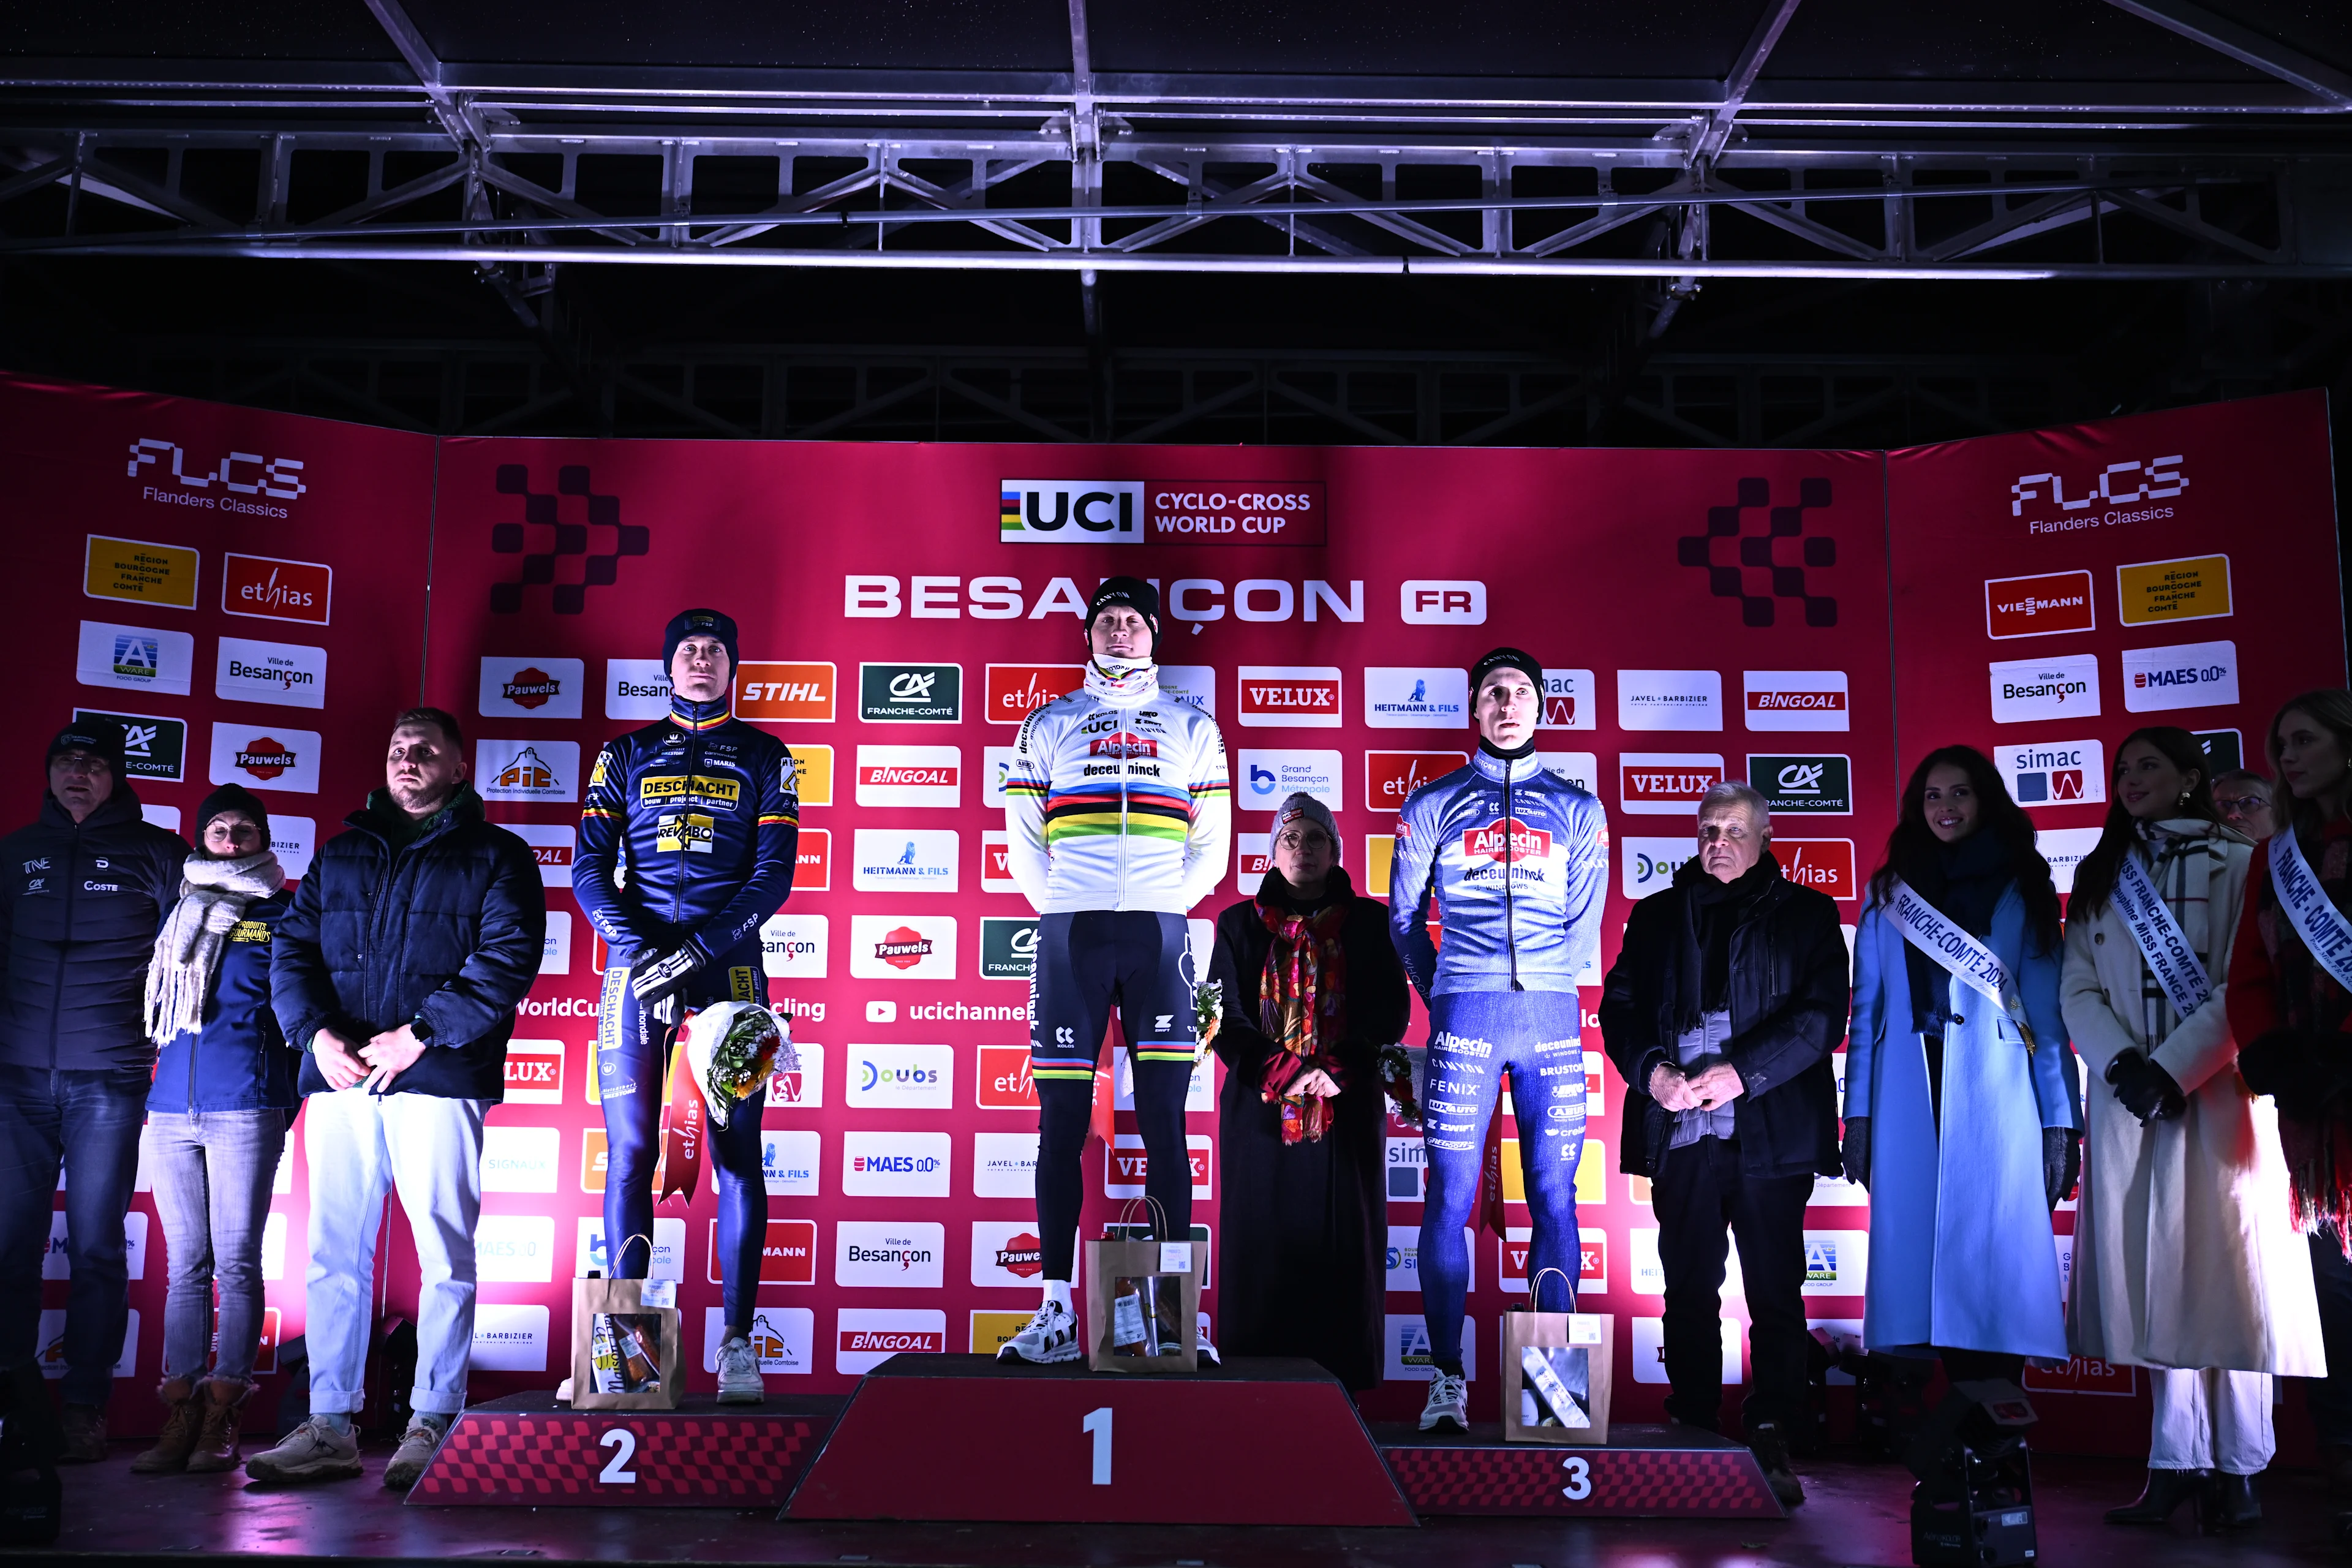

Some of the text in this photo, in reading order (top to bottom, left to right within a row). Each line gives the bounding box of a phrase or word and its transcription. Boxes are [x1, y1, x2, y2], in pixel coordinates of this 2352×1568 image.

[143, 486, 288, 519] Flanders Classics
[1155, 492, 1311, 512] CYCLO-CROSS
[1026, 492, 1133, 532] UCI
[2030, 505, 2174, 535] Flanders Classics
[1155, 516, 1286, 535] WORLD CUP
[121, 573, 162, 585] FRANCHE
[241, 567, 313, 610] ethias
[2154, 592, 2196, 603] FRANCHE
[844, 575, 1472, 636] BESAÇON FR
[267, 657, 283, 666] Ville
[121, 666, 150, 676] WARE
[230, 661, 313, 690] Besançon
[2038, 673, 2055, 681] Ville
[2147, 668, 2198, 688] MAES
[507, 682, 556, 696] Pauwels
[742, 682, 826, 702] STIHL
[2003, 681, 2087, 704] Besançon
[867, 706, 953, 716] FRANCHE-COMTÉ
[1019, 703, 1053, 754] deceuninck
[1088, 720, 1118, 733] UCI
[1096, 740, 1151, 755] Alpecin
[239, 753, 292, 766] Pauwels
[2016, 748, 2082, 769] simac
[1084, 762, 1160, 777] deceuninck
[1281, 764, 1311, 773] Grand
[644, 780, 736, 797] DESCHACHT
[1281, 774, 1329, 786] Besançon
[1281, 783, 1330, 794] Métropole
[644, 797, 662, 806] bouw
[706, 797, 734, 808] partner
[1765, 799, 1844, 808] RANCHE-COMTÉ
[1473, 831, 1542, 852] Alpecin
[1463, 865, 1545, 883] deceuninck
[1781, 848, 1838, 886] thias
[83, 881, 118, 892] COSTE
[2275, 845, 2316, 911] FRANCHE
[238, 921, 267, 931] PRODUITS
[742, 913, 760, 932] FSP
[228, 928, 271, 942] GOURMANDS
[2130, 878, 2204, 989] FRANCHE-COMTÉ
[878, 943, 929, 956] Pauwels
[1895, 894, 2008, 993] FRANCHE-COMTÉ 2024
[2135, 921, 2188, 1003] MISS FRANCE
[605, 970, 623, 1046] DESCHACHT
[1434, 1031, 1493, 1055] Alpecin
[1452, 1048, 1490, 1058] BOOSTER
[1552, 1049, 1578, 1058] WINDOWS
[505, 1061, 552, 1082] LUX
[1431, 1058, 1485, 1074] CANYON
[1430, 1078, 1477, 1096] FENIX
[1553, 1105, 1585, 1117] ABUS
[673, 1099, 700, 1159] ethias
[1439, 1123, 1476, 1133] ZWIFT
[867, 1156, 914, 1173] MAES
[1483, 1145, 1499, 1202] ethias
[788, 1170, 810, 1178] FILS
[849, 1246, 931, 1272] Besançon
[1000, 1251, 1042, 1263] Pauwe
[1082, 1407, 1113, 1486] 1
[599, 1428, 636, 1484] 2
[1562, 1456, 1592, 1500] 3
